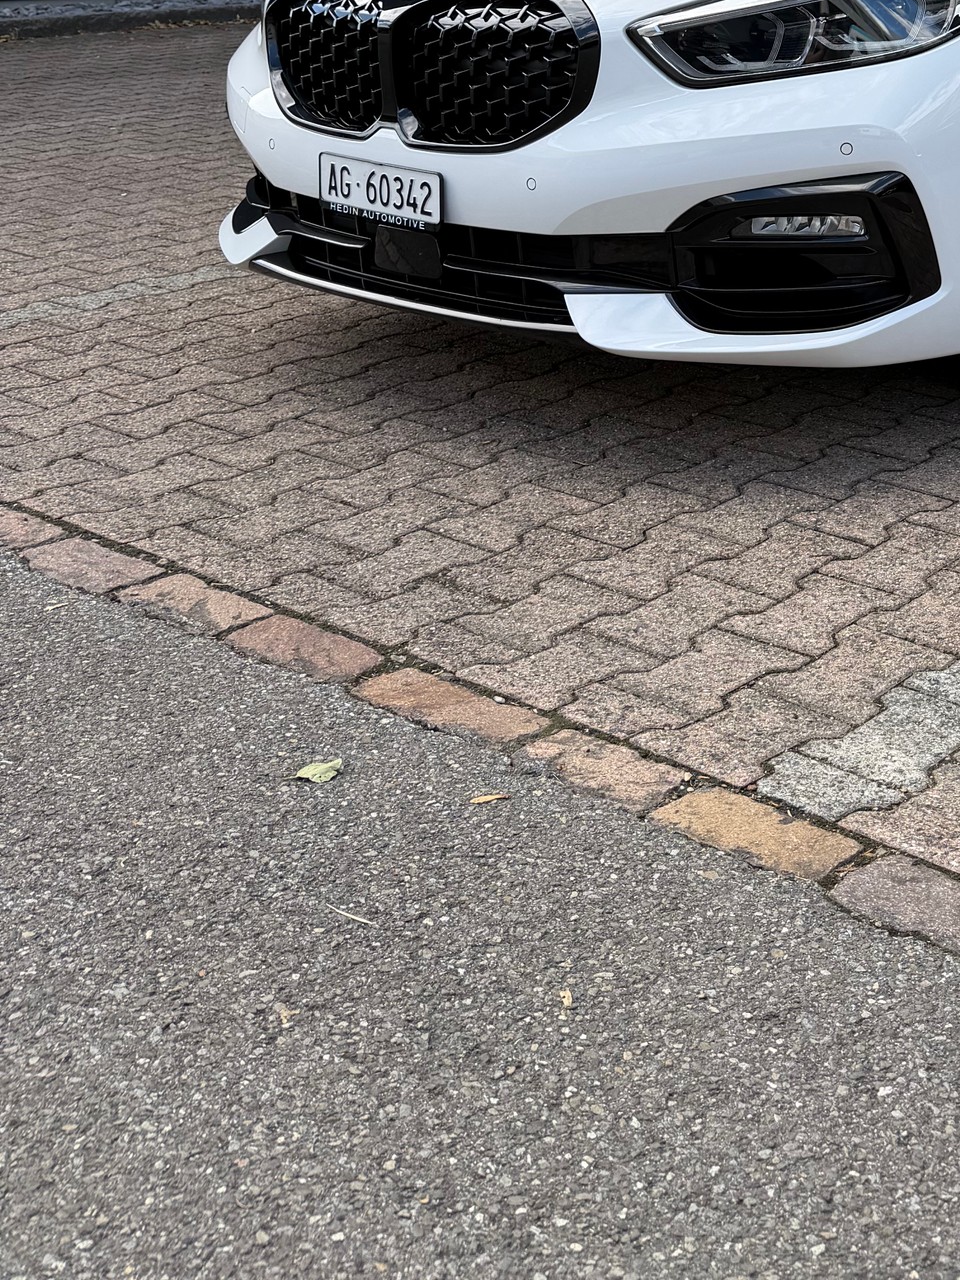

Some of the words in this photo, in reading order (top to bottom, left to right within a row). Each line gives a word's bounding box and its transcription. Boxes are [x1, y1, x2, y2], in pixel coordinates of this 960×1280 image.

[328, 163, 351, 198] AG
[366, 171, 432, 216] 60342
[330, 203, 359, 216] HEDIN
[362, 209, 425, 230] AUTOMOTIVE
